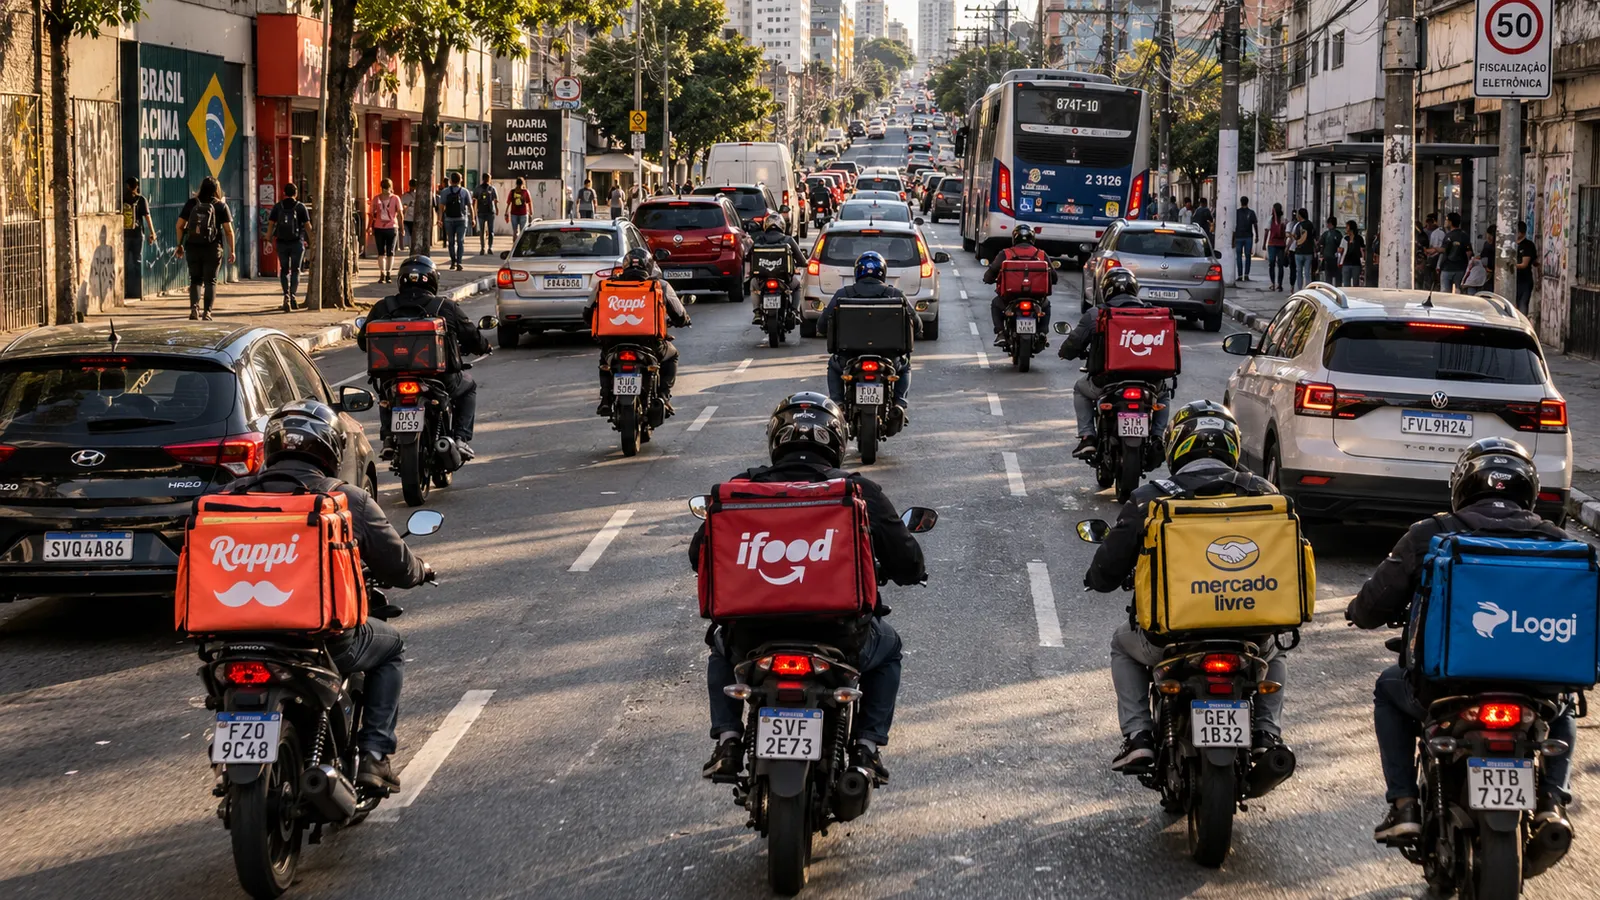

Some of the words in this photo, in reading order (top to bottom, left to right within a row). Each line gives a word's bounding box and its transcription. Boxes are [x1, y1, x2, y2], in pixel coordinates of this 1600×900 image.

[1497, 13, 1532, 38] 50
[1479, 61, 1547, 75] FISCALIZAÇÃO
[140, 67, 184, 104] BRASIL
[1482, 76, 1542, 88] ELETRÔNICA
[1056, 98, 1099, 112] 874T-10
[140, 107, 180, 141] ACIMA
[506, 119, 547, 129] PADARIA
[506, 133, 548, 142] LANCHES
[507, 146, 546, 158] ALMOÇO
[141, 147, 155, 179] DE
[157, 148, 186, 179] TUDO
[507, 161, 544, 171] JANTAR
[1085, 174, 1093, 185] 2
[1095, 175, 1122, 187] 3126
[607, 295, 646, 312] Rappi
[1119, 329, 1166, 348] ifood
[1408, 418, 1466, 434] FVL9H24
[51, 540, 124, 558] SVQ4A86
[209, 533, 300, 573] Rappi
[736, 528, 835, 570] ifood
[1191, 575, 1278, 594] mercado
[1214, 594, 1256, 612] livre
[1511, 610, 1577, 643] Loggi
[1204, 709, 1238, 726] GEK
[772, 718, 808, 737] SVF
[1200, 726, 1244, 744] 1B32
[221, 741, 269, 760] 9C48
[765, 736, 813, 756] 2E73
[1482, 769, 1520, 786] RTB
[1477, 787, 1527, 806] 7J24
